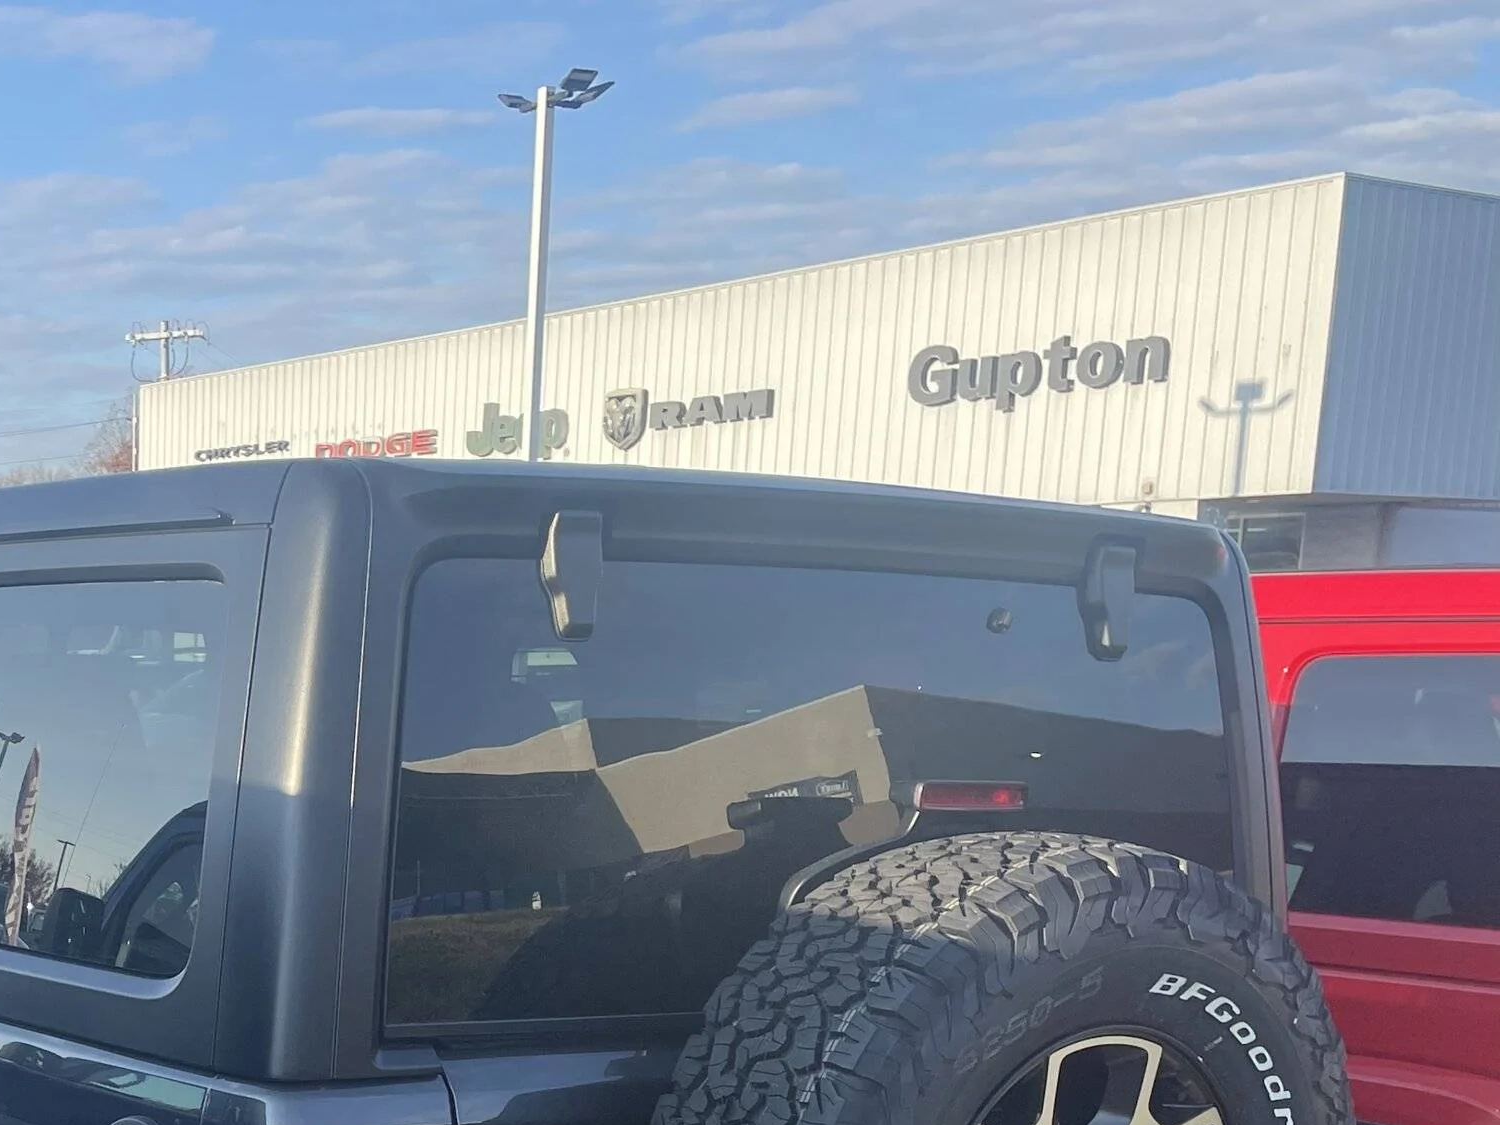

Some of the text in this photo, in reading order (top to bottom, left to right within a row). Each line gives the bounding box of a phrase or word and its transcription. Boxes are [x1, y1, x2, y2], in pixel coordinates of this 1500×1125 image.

[908, 335, 1171, 413] Gupton
[649, 389, 774, 430] RAM
[194, 440, 290, 462] CHRYSLER
[315, 429, 438, 458] DODGE
[467, 402, 569, 459] Jep
